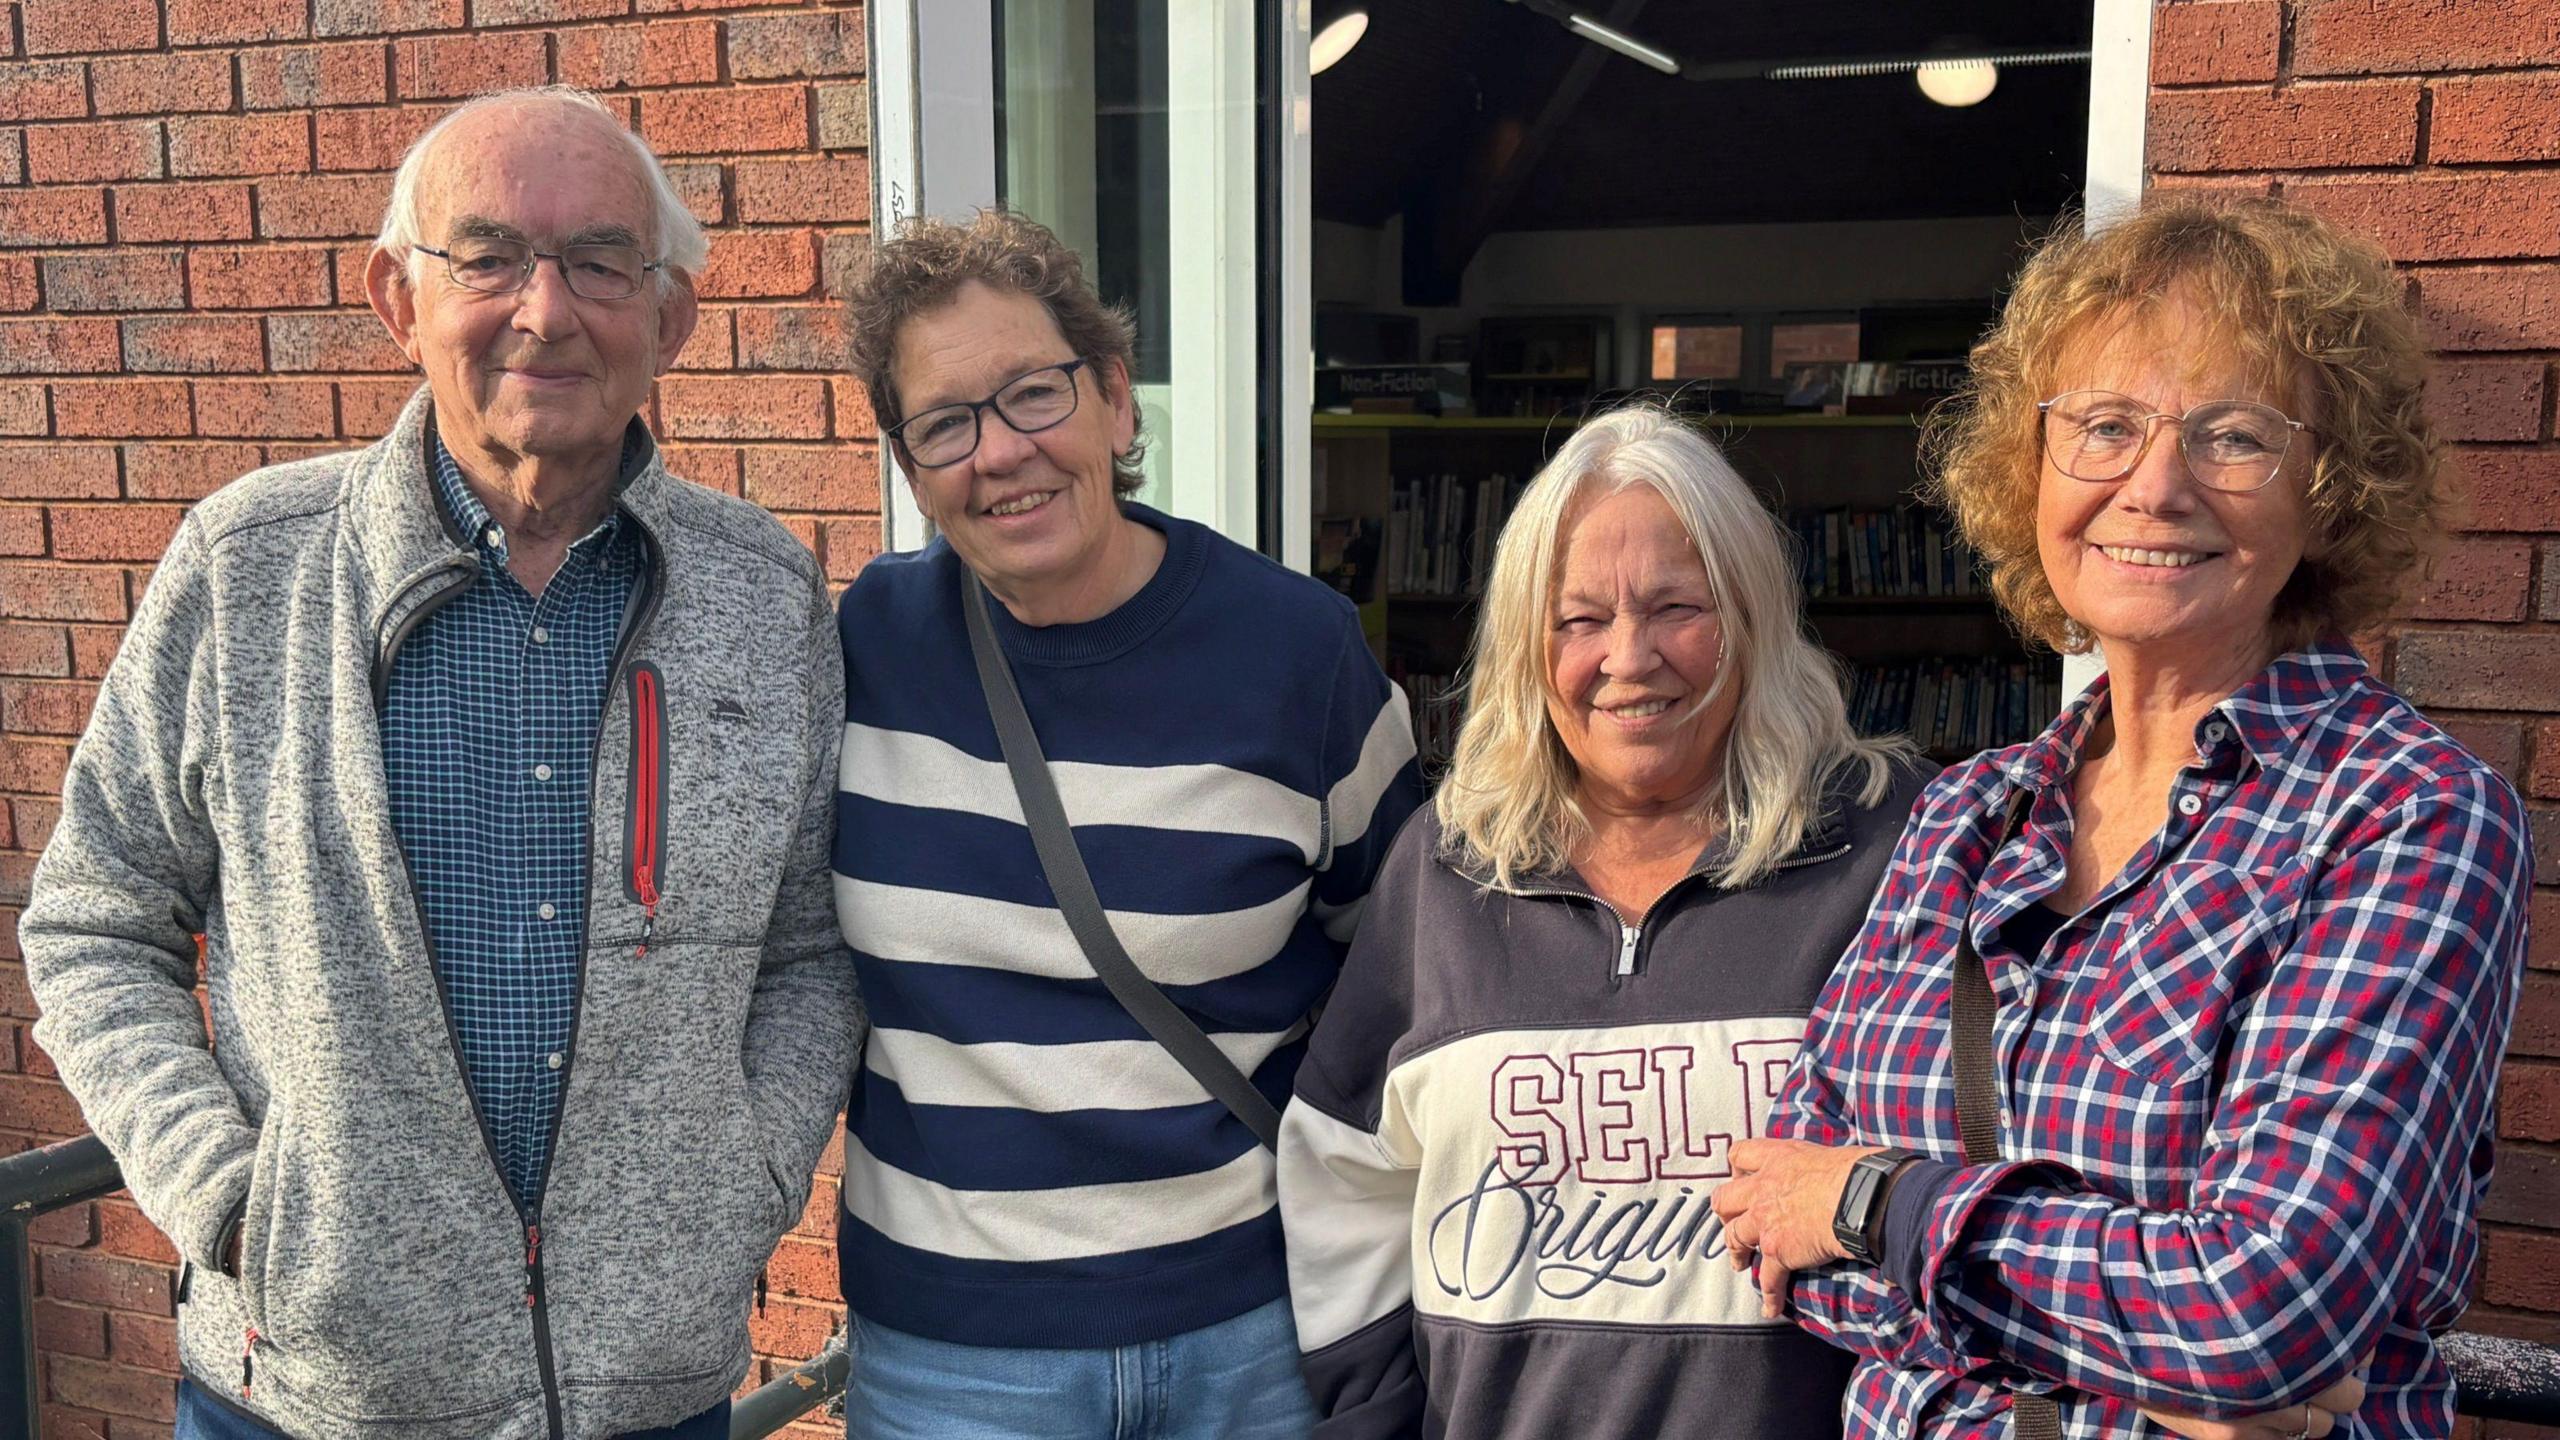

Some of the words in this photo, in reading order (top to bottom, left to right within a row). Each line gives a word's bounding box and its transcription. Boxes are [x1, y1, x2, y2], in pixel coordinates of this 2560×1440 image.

[1340, 371, 1437, 393] Non-Fiction
[1831, 367, 1965, 390] N-Fictio
[1429, 1144, 1727, 1301] Origin
